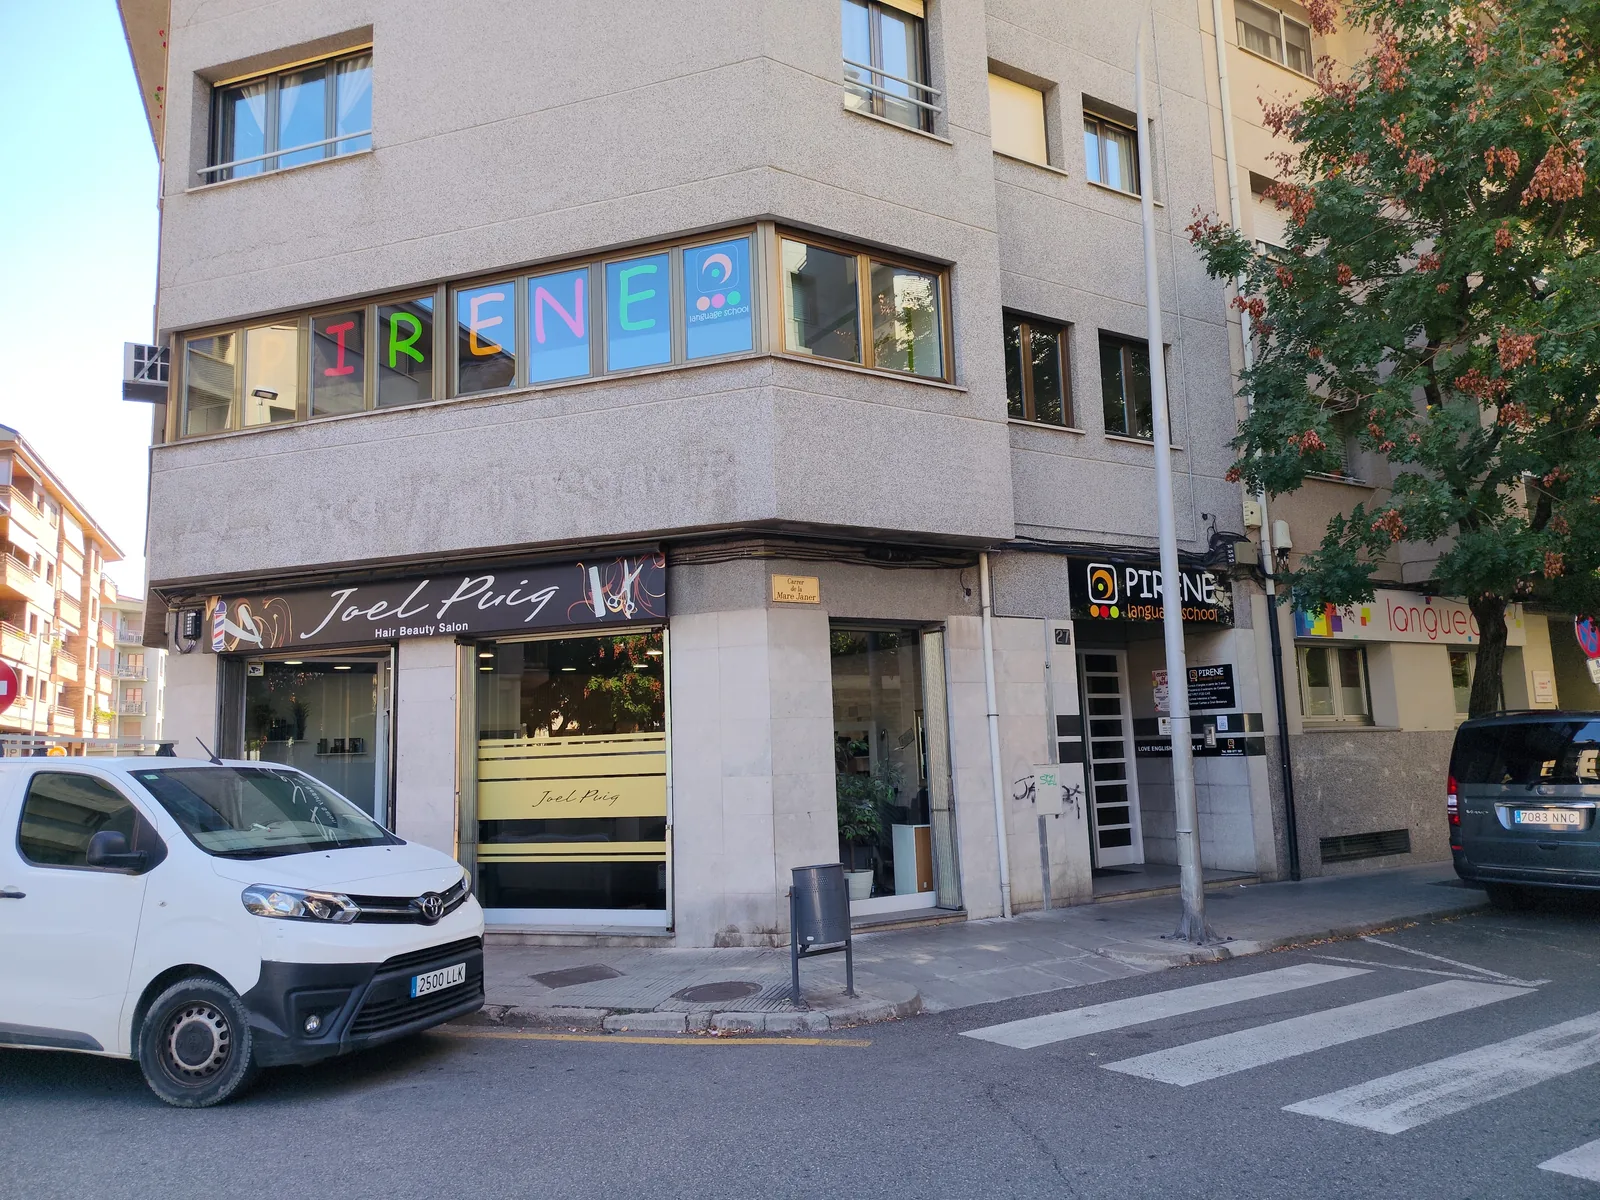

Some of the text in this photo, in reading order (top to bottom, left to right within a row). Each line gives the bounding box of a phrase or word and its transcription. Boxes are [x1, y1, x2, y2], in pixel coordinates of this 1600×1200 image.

[689, 305, 749, 323] language school
[1125, 567, 1216, 604] PIRNE
[777, 592, 794, 600] Mare
[300, 575, 560, 639] Joel Puig
[1181, 608, 1218, 622] school
[375, 622, 469, 638] Hair Beauty Salon
[1055, 629, 1069, 644] 27
[1198, 667, 1224, 677] PIRENE
[532, 789, 620, 807] Joel Puig
[1521, 812, 1576, 824] 7083 NNC
[419, 966, 464, 993] 2500 LLK
